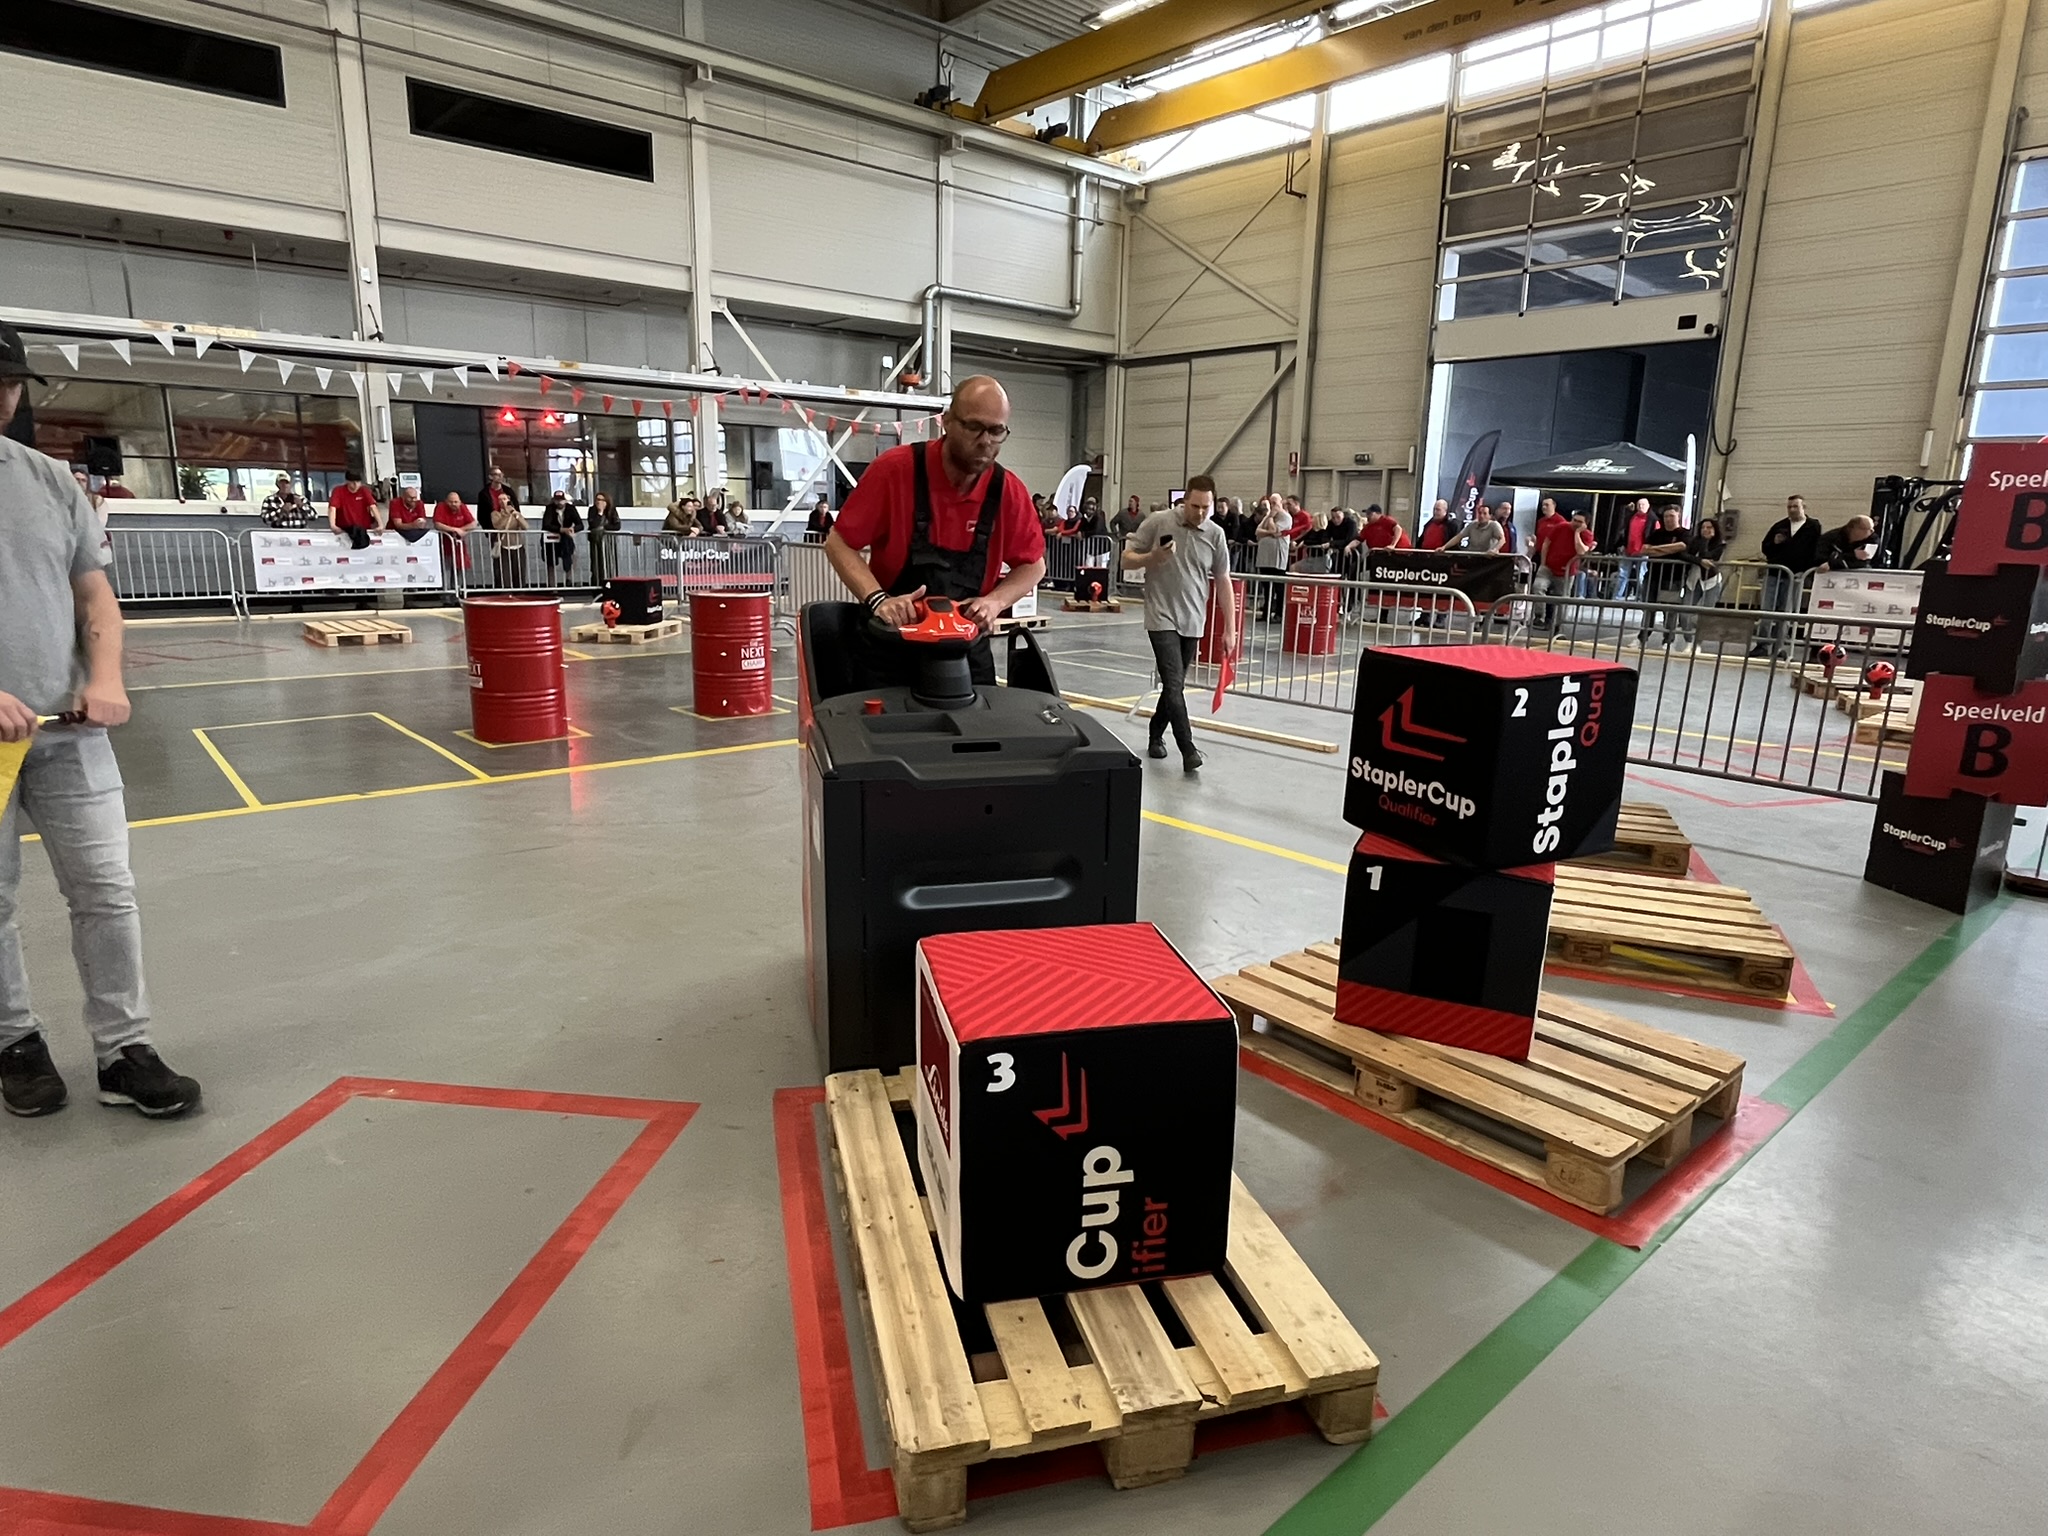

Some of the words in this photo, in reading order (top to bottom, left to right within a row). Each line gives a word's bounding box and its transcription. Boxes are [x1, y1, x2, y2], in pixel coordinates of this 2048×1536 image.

[1402, 28, 1422, 41] van
[1426, 19, 1449, 34] den
[1453, 10, 1482, 26] Berg
[2005, 491, 2048, 551] B
[1375, 566, 1448, 585] StaplerCup
[1925, 613, 1991, 633] StaplerCup
[741, 646, 764, 659] NEXT
[1511, 688, 1529, 717] 2
[1580, 674, 1607, 747] Qual
[1942, 702, 2046, 723] Speelveld
[1533, 676, 1580, 854] Stapler
[1959, 723, 2012, 778] B
[1351, 756, 1476, 819] StaplerCup
[1378, 794, 1437, 826] Qualifier
[1883, 822, 1946, 852] StaplerCup
[1366, 865, 1383, 891] 1
[986, 1052, 1016, 1092] 3
[1066, 1145, 1134, 1279] Cup
[1131, 1197, 1169, 1274] ifier
